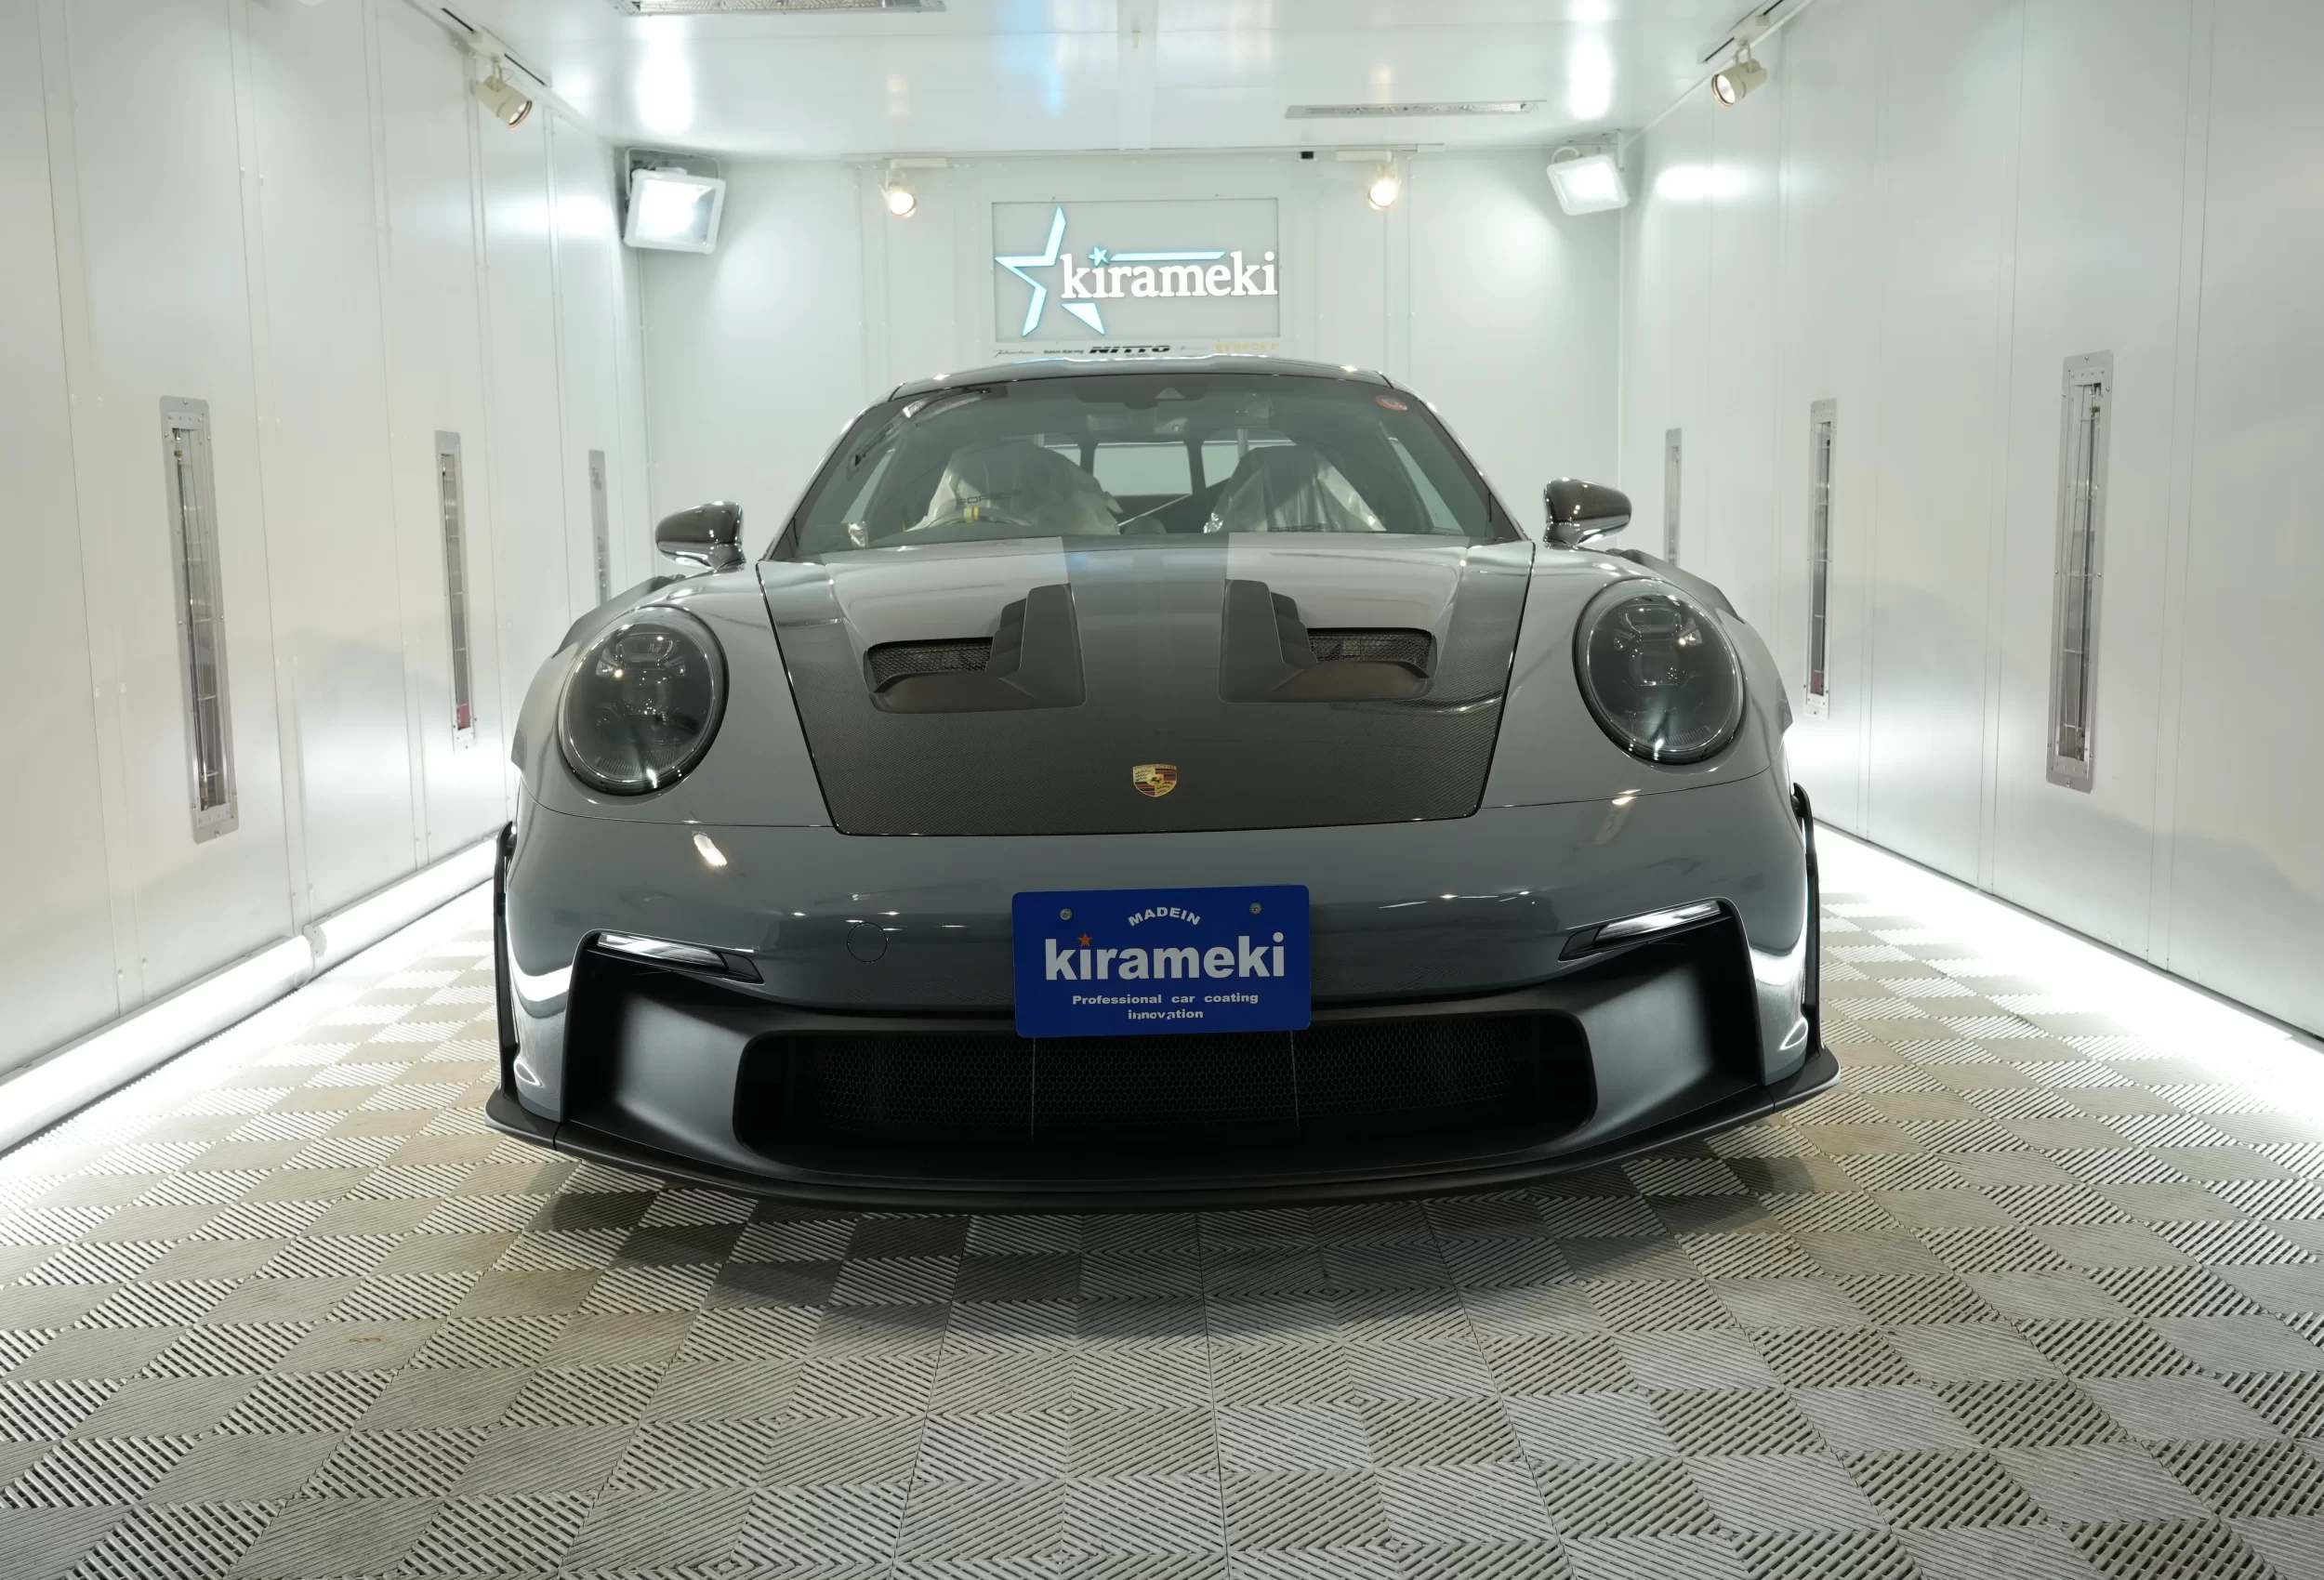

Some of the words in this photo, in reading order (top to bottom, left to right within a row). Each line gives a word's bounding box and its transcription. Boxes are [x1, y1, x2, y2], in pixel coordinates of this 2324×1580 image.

[1060, 249, 1278, 298] kirameki
[1089, 345, 1171, 354] NITTO
[1128, 906, 1201, 927] MADEIN
[1045, 931, 1285, 981] kirameki
[1073, 994, 1162, 1005] Professional
[1171, 994, 1195, 1004] car
[1204, 993, 1259, 1004] coating
[1128, 1008, 1204, 1020] innovation
